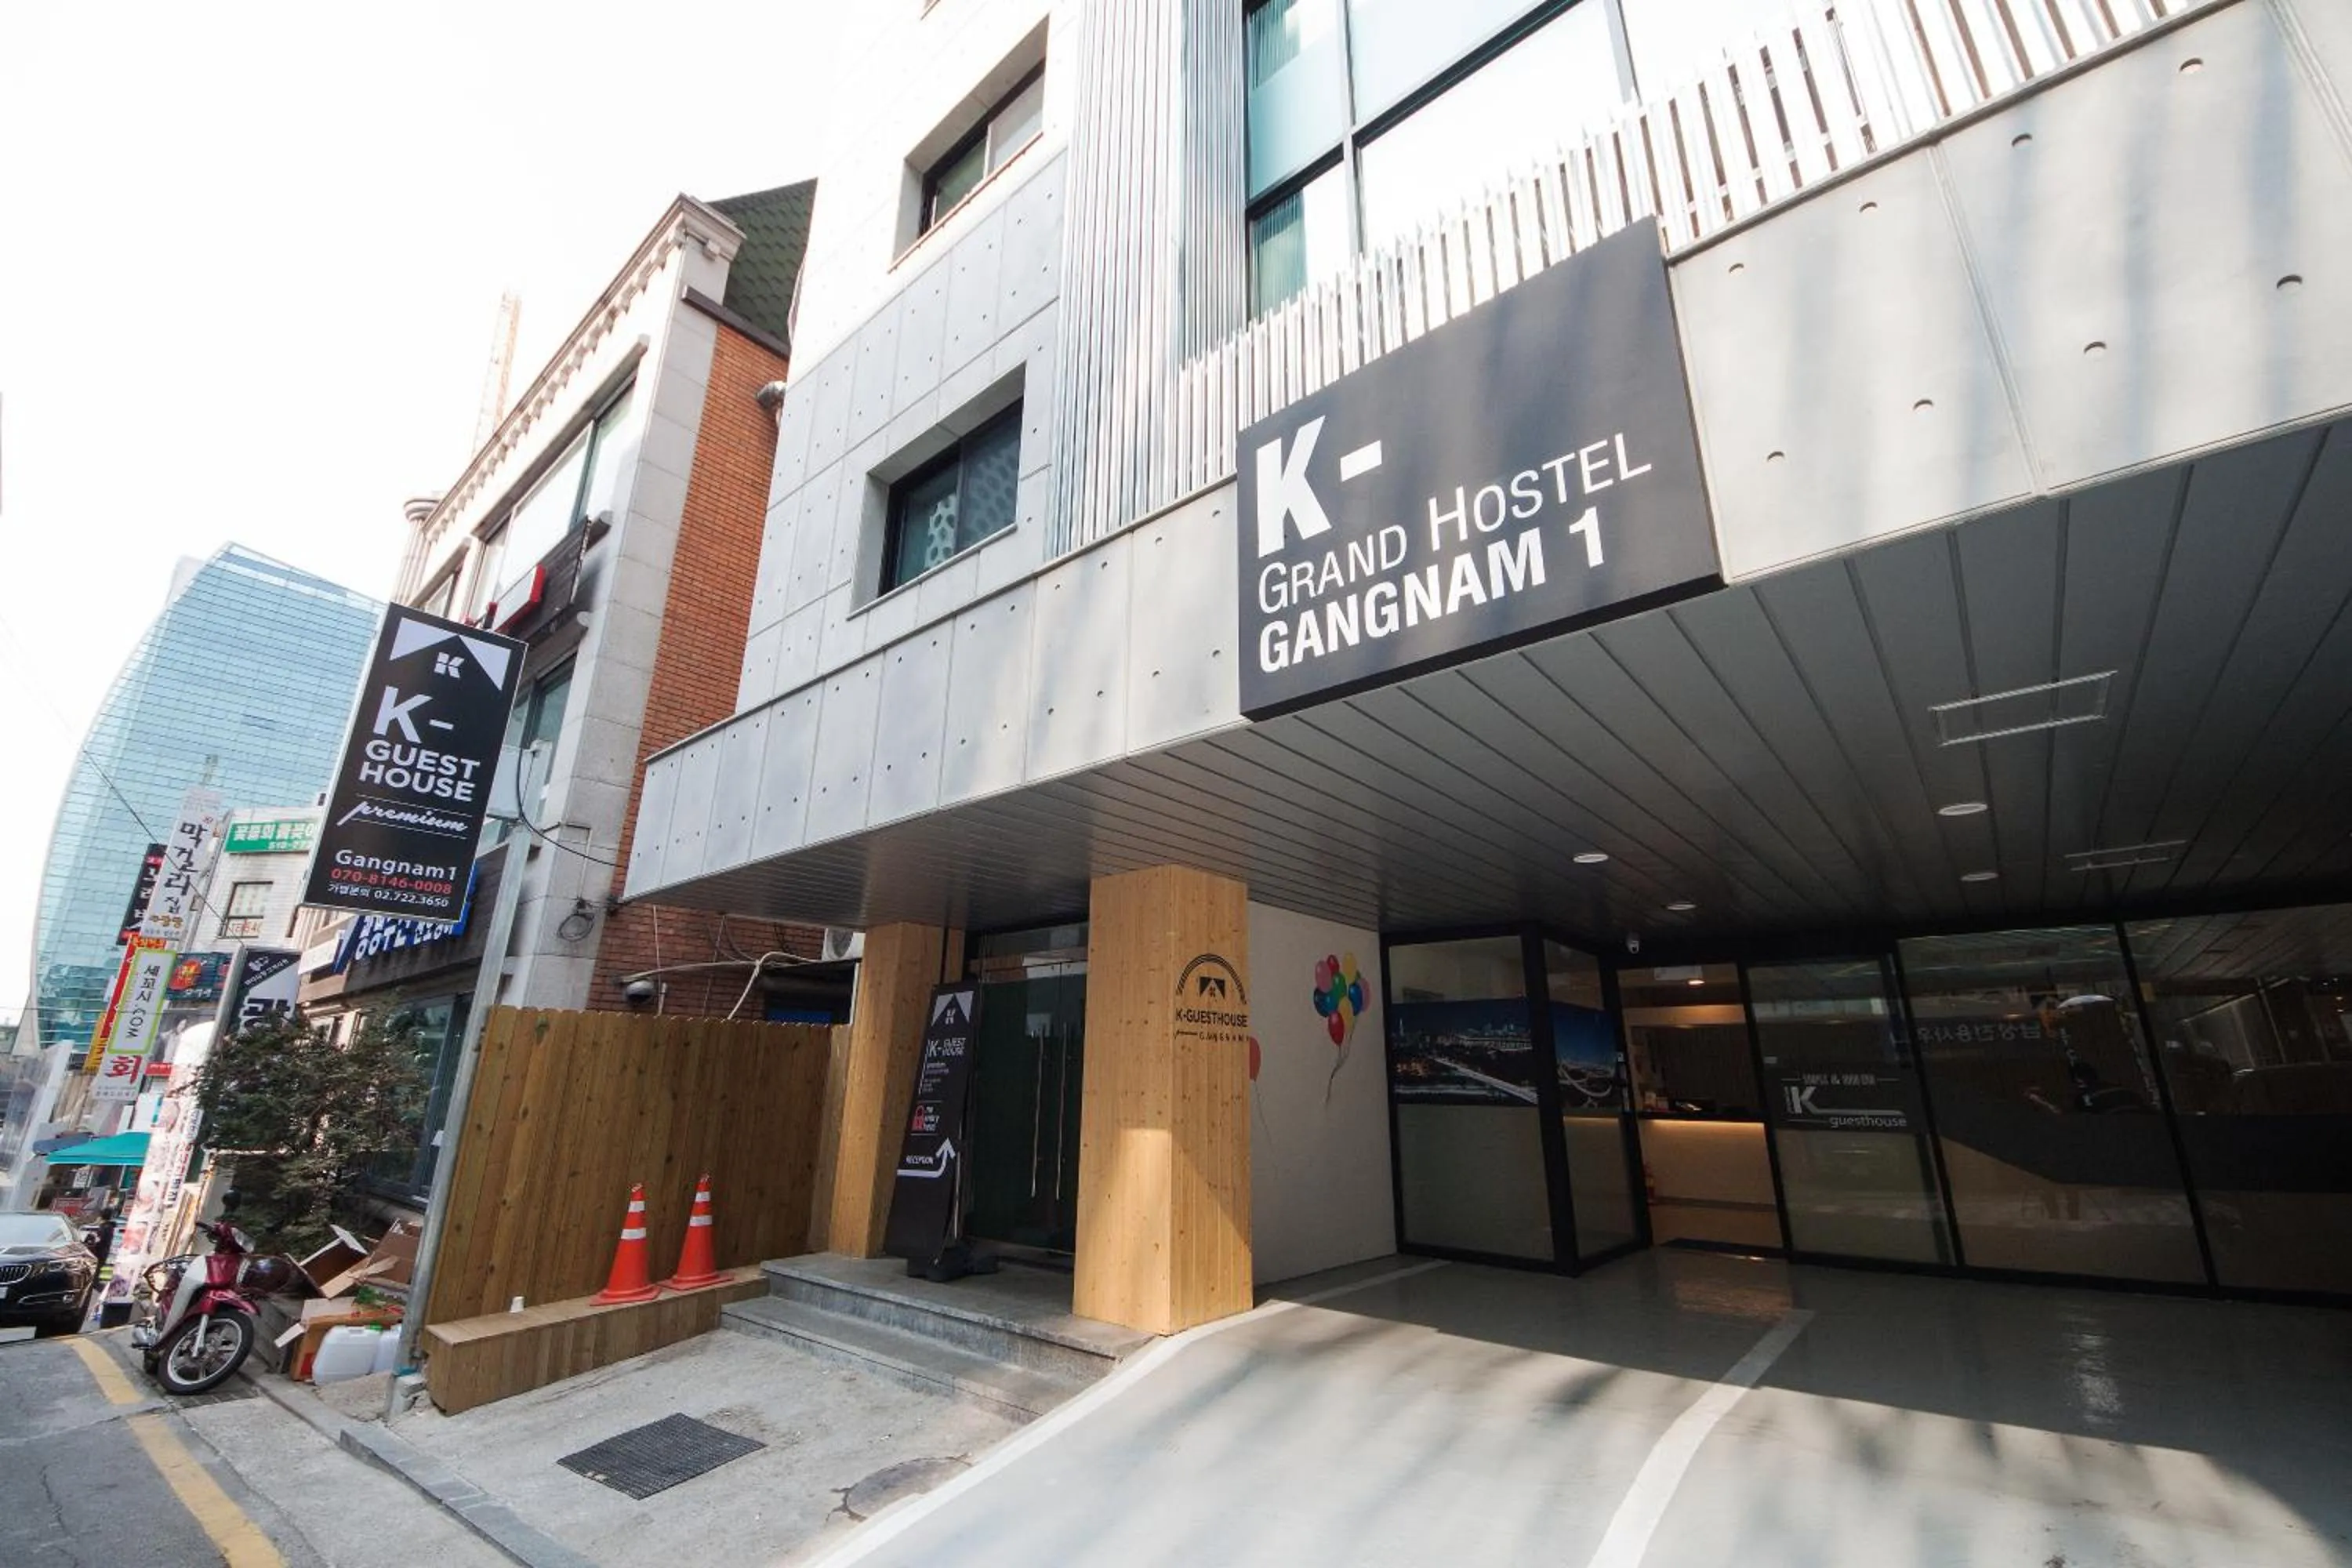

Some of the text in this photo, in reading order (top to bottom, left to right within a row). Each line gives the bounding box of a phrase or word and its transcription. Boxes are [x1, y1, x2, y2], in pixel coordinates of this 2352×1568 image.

[1257, 416, 1382, 558] K-
[1258, 432, 1653, 615] GRAND HOSTEL
[1259, 506, 1605, 673] GANGNAM 1
[372, 685, 454, 744] K-
[365, 739, 481, 780] GUEST
[358, 760, 477, 802] HOUSE
[337, 800, 469, 833] premium
[331, 867, 452, 895] 070-8146-0008
[335, 848, 458, 881] Gangnam1
[1176, 1009, 1249, 1028] K-GUESTHOUSE
[1829, 1113, 1907, 1129] guesthouse
